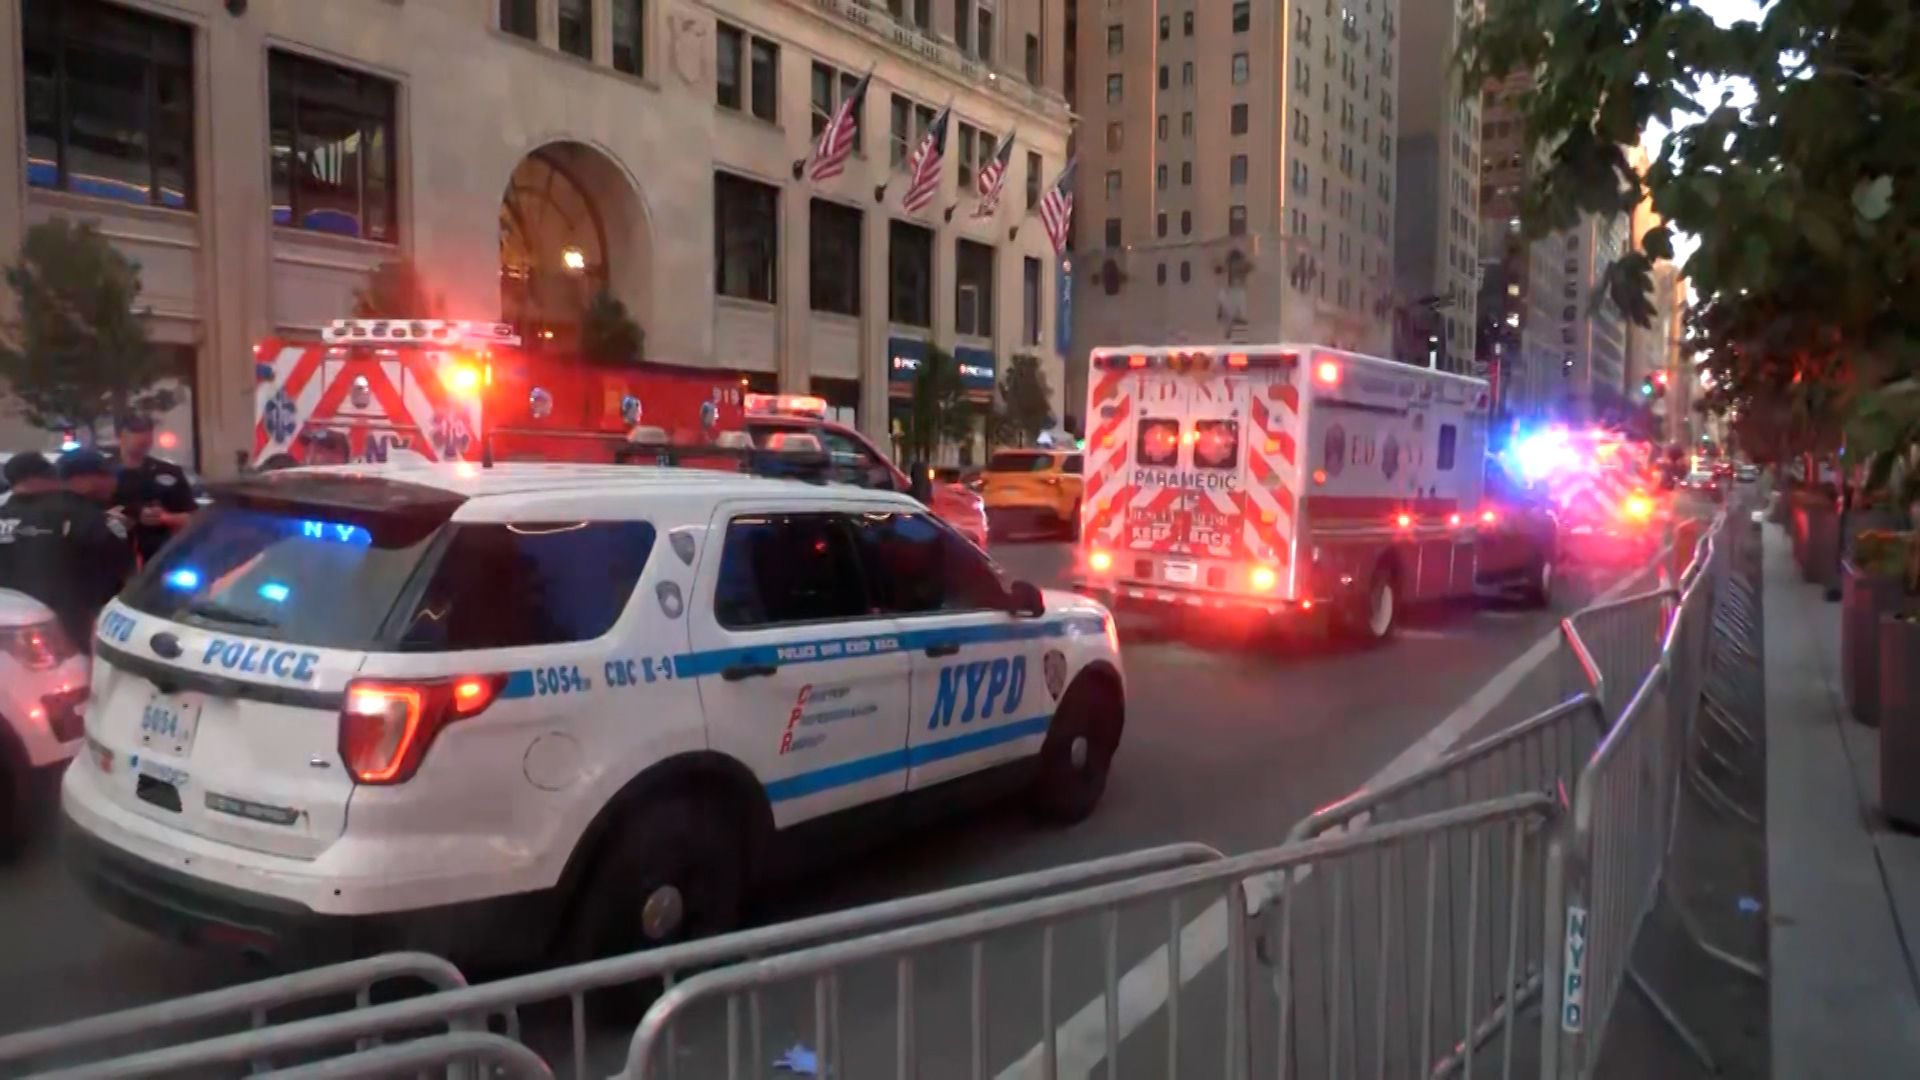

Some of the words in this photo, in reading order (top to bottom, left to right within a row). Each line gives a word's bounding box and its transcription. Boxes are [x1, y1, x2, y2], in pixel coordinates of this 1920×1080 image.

[1134, 471, 1238, 491] PARAMEDIC
[202, 638, 321, 682] POLICE
[535, 665, 583, 696] 5054
[642, 655, 673, 683] K-9
[927, 655, 1027, 731] NYPD
[1566, 913, 1587, 1027] NYPD
